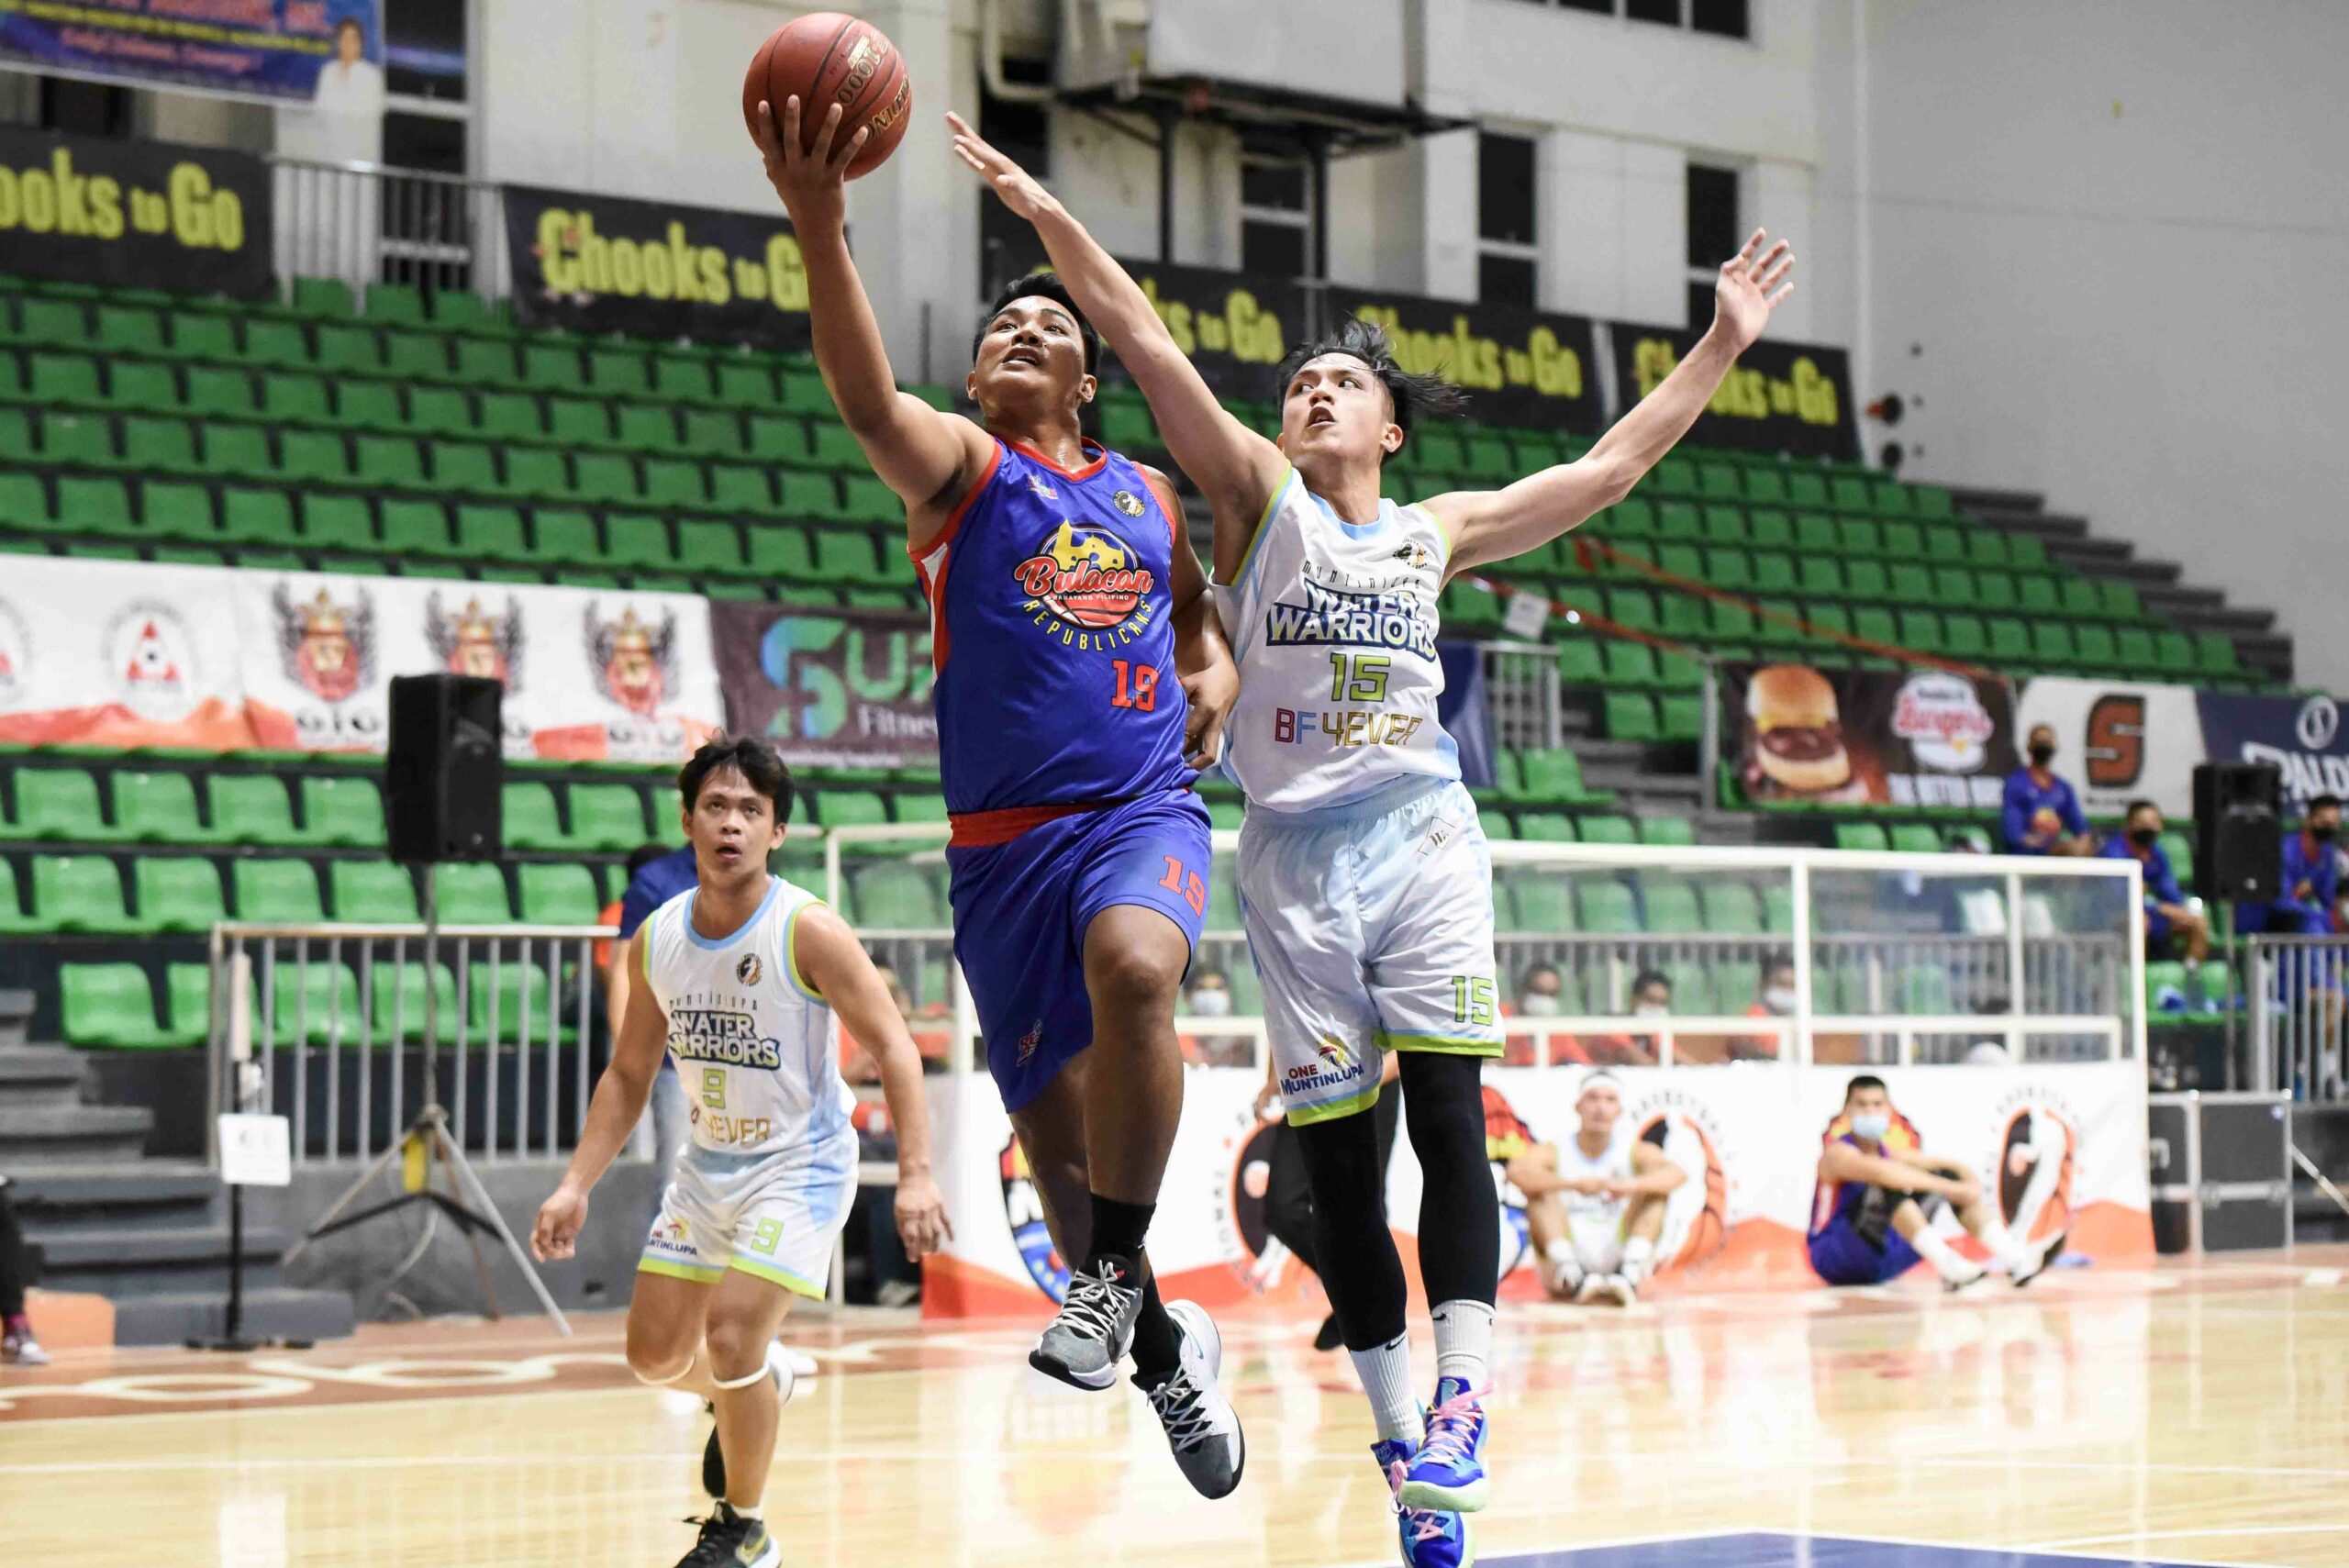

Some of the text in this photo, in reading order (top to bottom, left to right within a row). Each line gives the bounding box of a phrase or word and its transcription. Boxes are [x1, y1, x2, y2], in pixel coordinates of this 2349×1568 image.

[129, 186, 168, 235] to
[169, 161, 244, 251] Go
[537, 207, 731, 306] Chooks
[733, 256, 769, 301] to
[1226, 288, 1284, 364] Go
[1529, 324, 1583, 399] Go
[1792, 355, 1840, 427] Go
[1014, 556, 1154, 597] Bulacan
[1303, 578, 1421, 620] WATER
[1023, 601, 1153, 651] REPUBLICANS
[1266, 602, 1438, 663] WARRIORS
[1110, 659, 1160, 713] 19
[1330, 652, 1391, 703] 15
[1274, 707, 1424, 747] BF 4EVER
[1157, 855, 1206, 918] 19
[671, 1010, 758, 1039] WATER
[1451, 974, 1493, 1027] 15
[668, 1032, 782, 1071] WRRIORS
[1288, 1063, 1319, 1079] ONE
[702, 1067, 728, 1109] 9
[1280, 1062, 1365, 1096] MUNTINLUPA
[750, 1217, 785, 1256] 9
